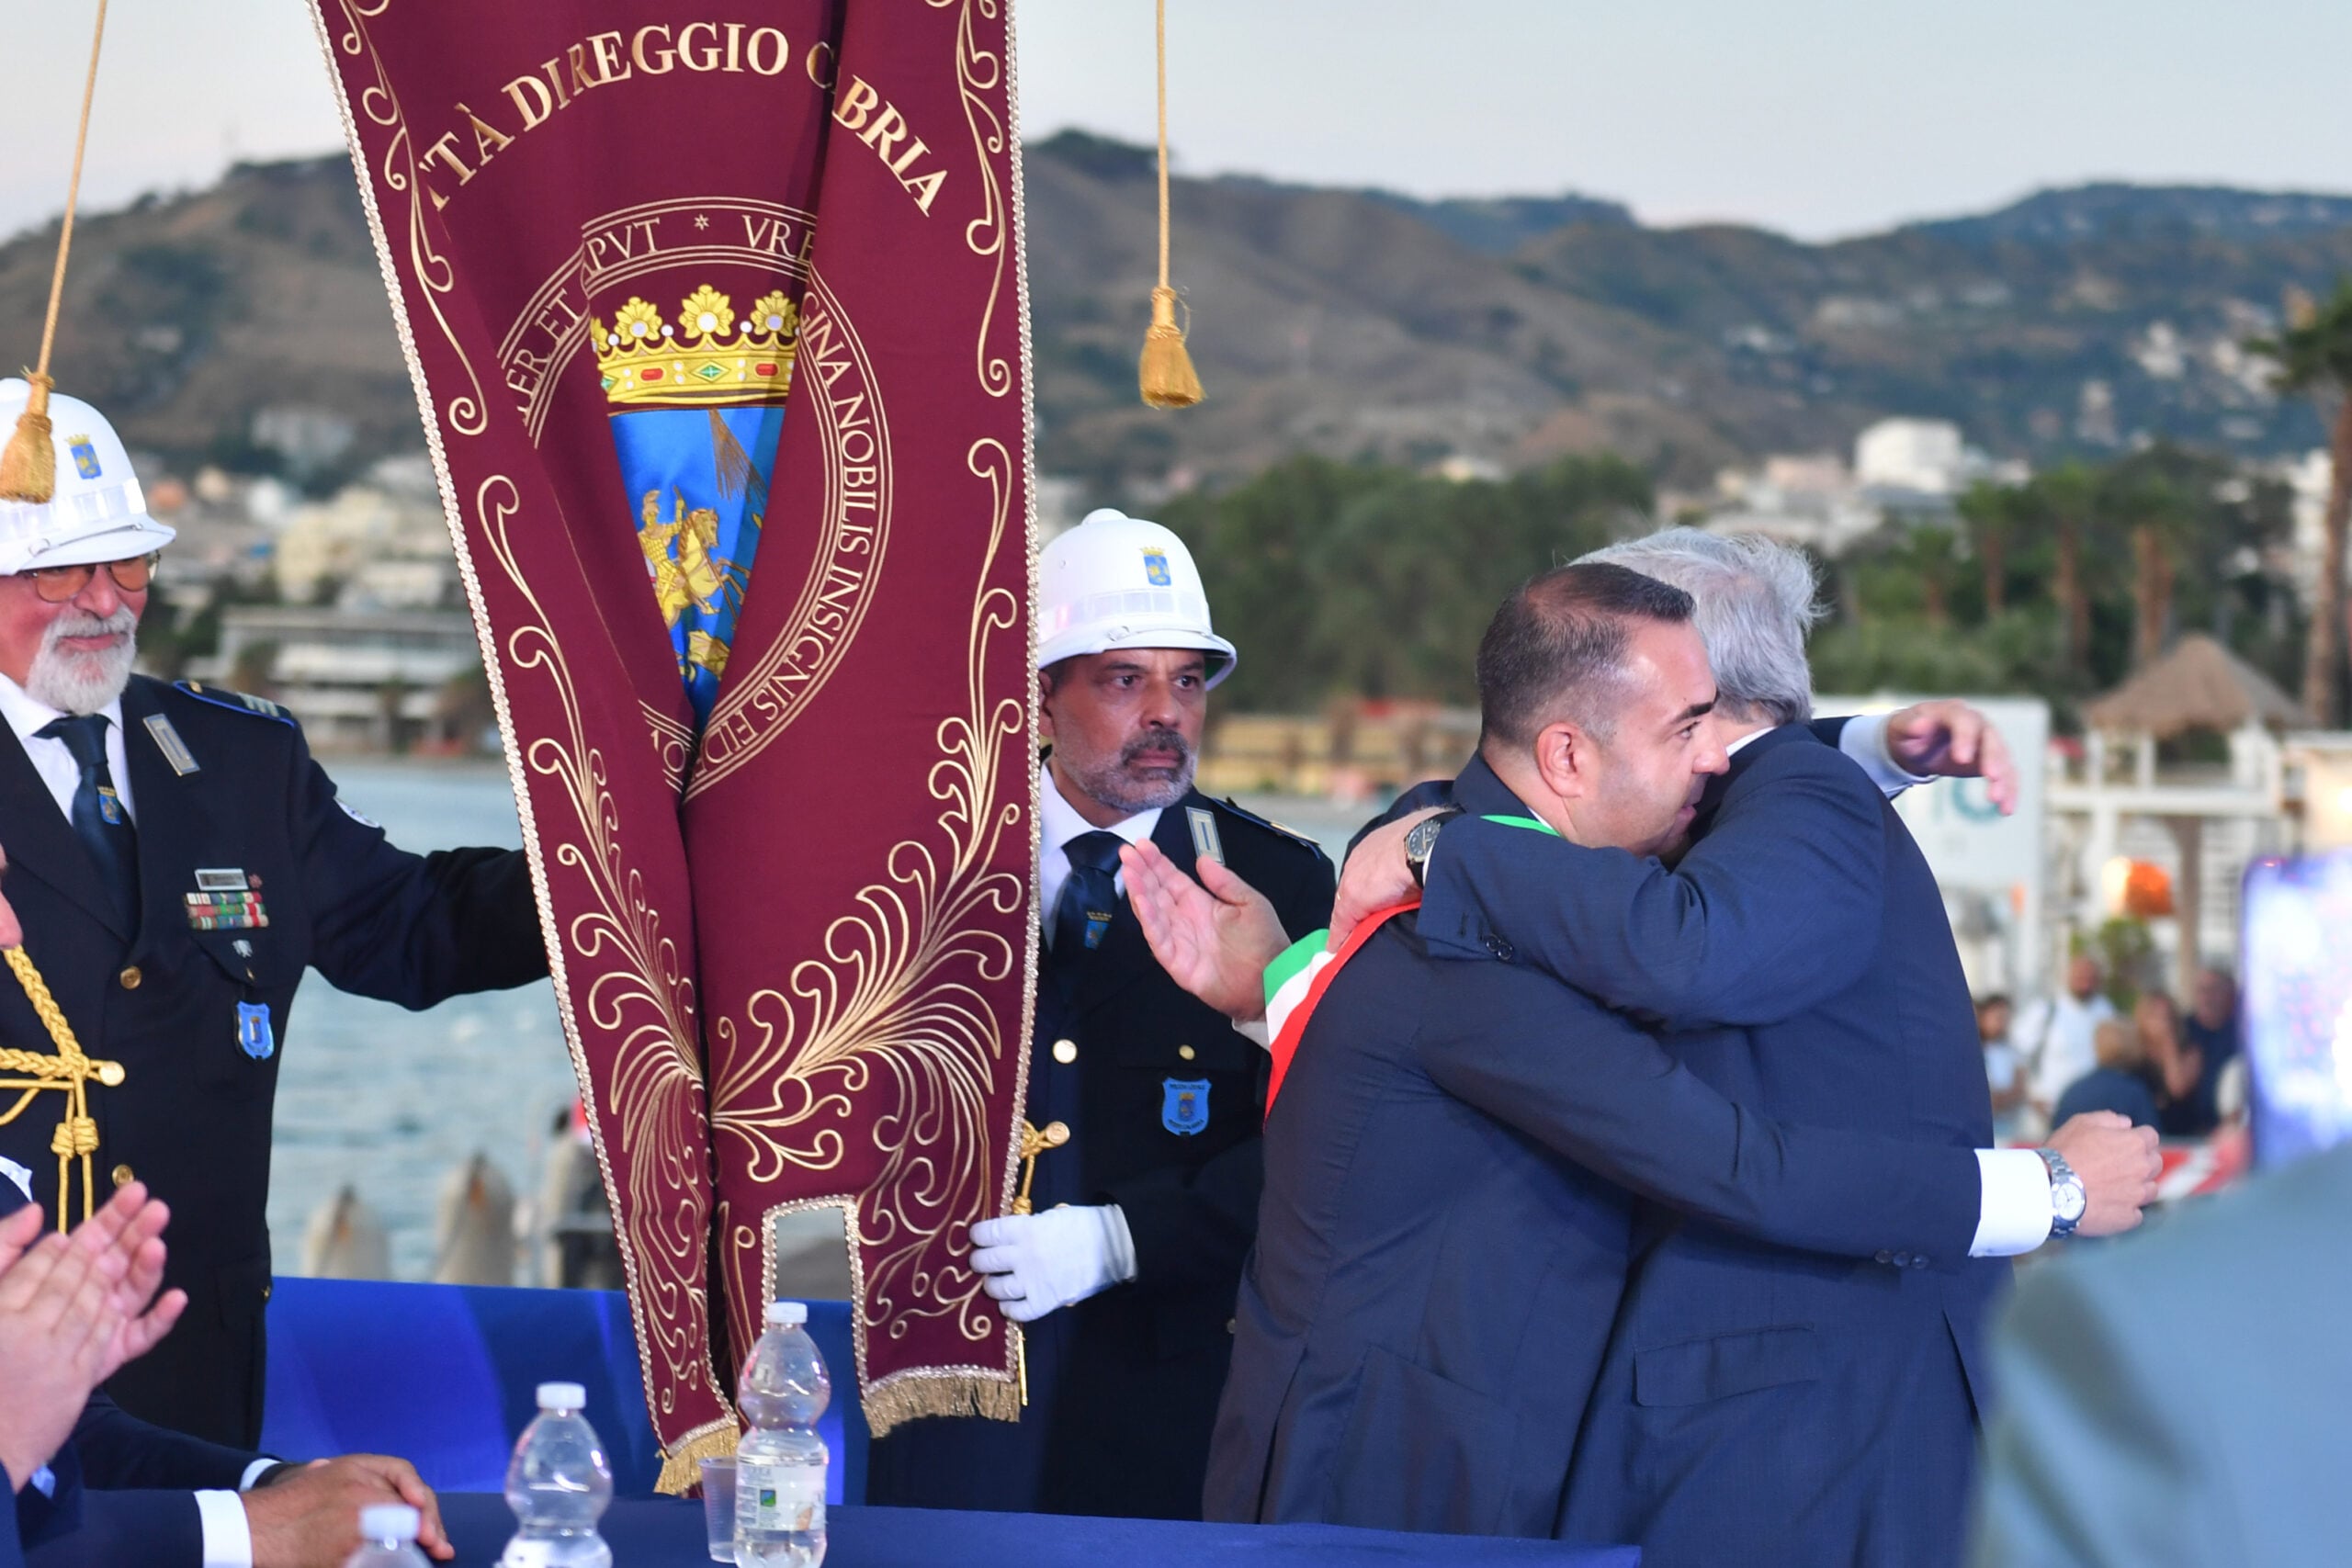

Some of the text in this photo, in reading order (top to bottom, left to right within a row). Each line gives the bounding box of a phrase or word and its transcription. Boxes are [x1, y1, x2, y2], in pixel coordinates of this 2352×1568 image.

[501, 57, 571, 132] DI
[565, 21, 789, 96] REGGIO
[806, 41, 947, 217] CBRIA
[534, 287, 582, 347] ET
[800, 291, 853, 389] GINA
[831, 391, 877, 555] NOBILIS
[752, 564, 864, 722] INSIGNIS
